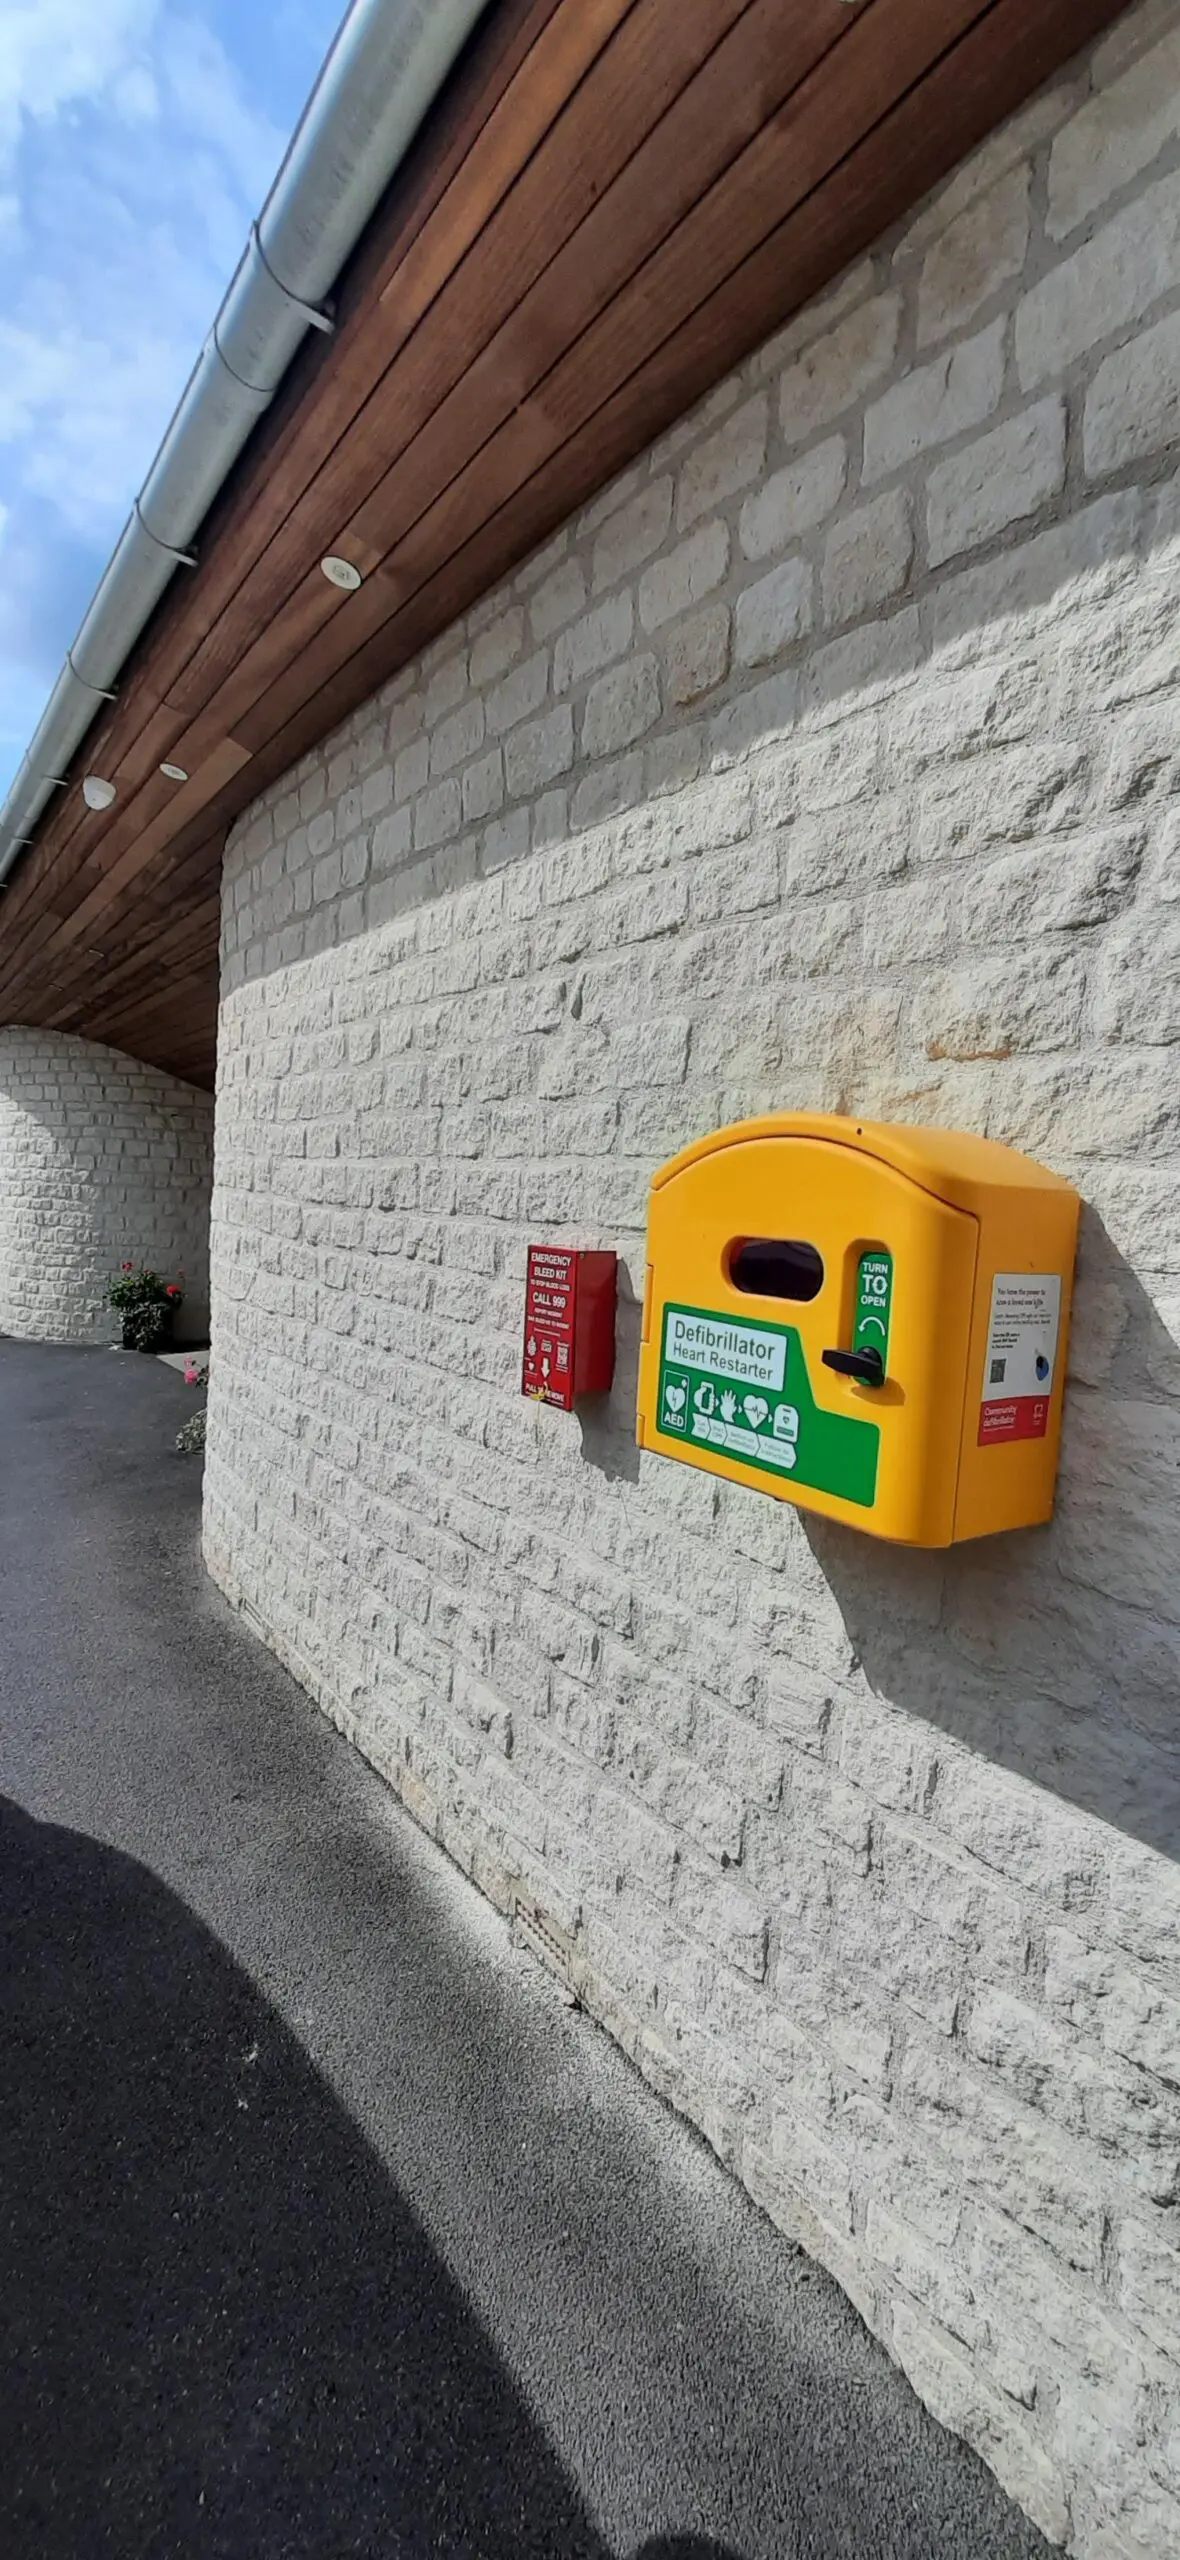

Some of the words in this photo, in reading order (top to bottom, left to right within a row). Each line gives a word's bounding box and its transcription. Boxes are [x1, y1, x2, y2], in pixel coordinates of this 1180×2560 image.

[531, 1252, 571, 1266] EMERGENCY
[534, 1266, 555, 1278] BLEED
[556, 1269, 567, 1280] KIT
[862, 1262, 888, 1273] TURN
[862, 1274, 888, 1294] TO
[533, 1292, 551, 1306] CALL
[552, 1295, 566, 1308] 999
[861, 1295, 886, 1307] OPEN
[675, 1320, 775, 1361] Defibrillator
[673, 1342, 705, 1363] Heart
[709, 1351, 774, 1381] Restarter
[526, 1382, 537, 1393] PULL
[984, 1405, 1017, 1416] Community
[664, 1412, 684, 1427] AED
